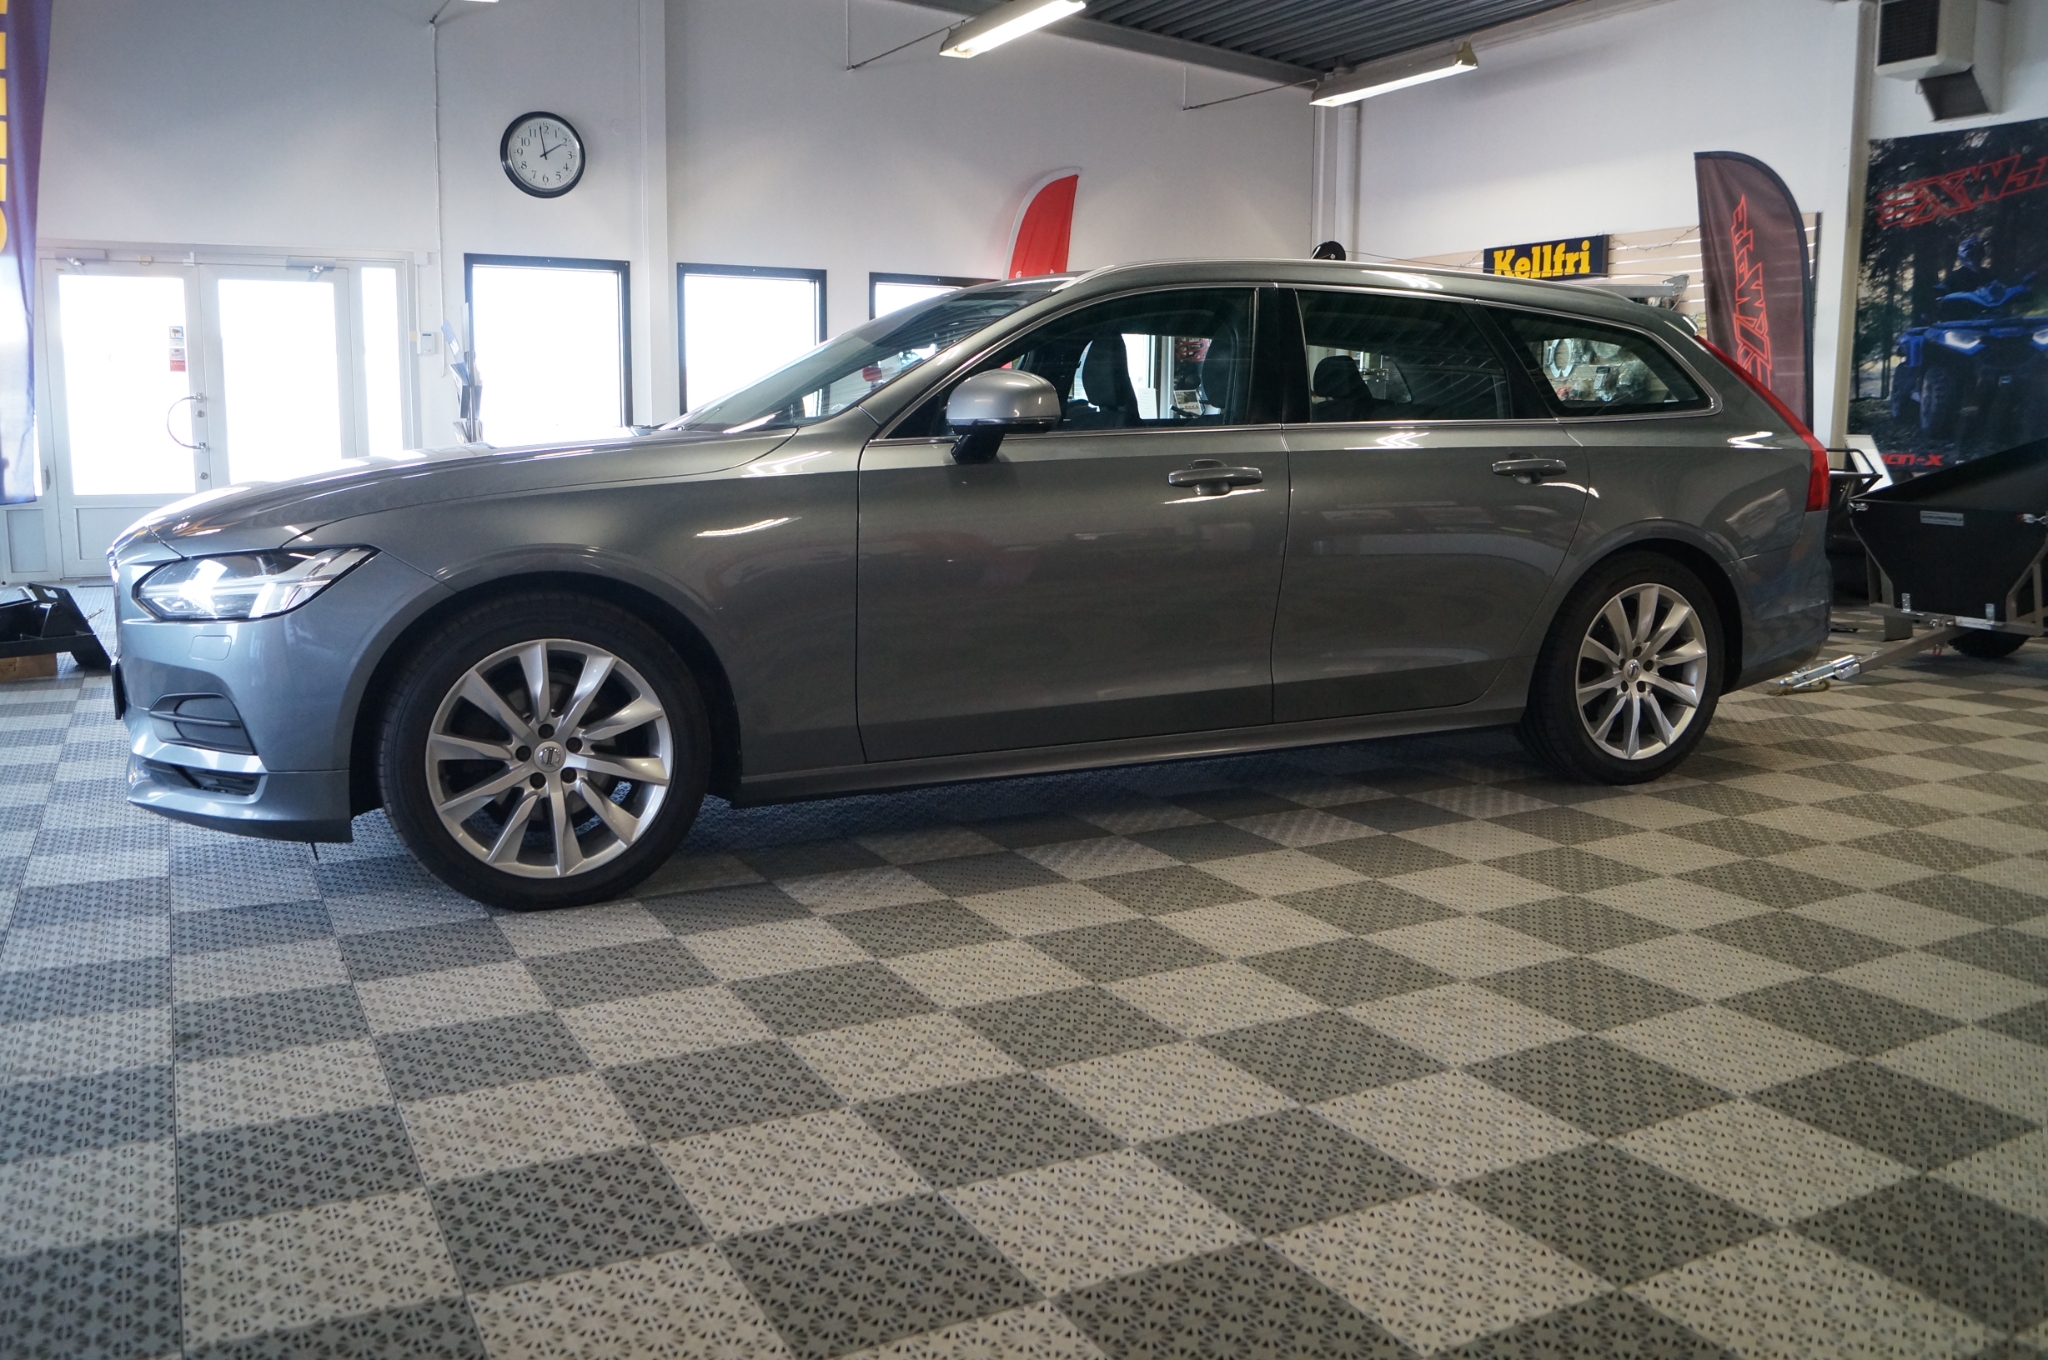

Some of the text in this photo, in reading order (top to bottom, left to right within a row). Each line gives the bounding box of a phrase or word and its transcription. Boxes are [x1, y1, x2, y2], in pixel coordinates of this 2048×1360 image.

[529, 128, 537, 138] 11
[539, 125, 549, 135] 2
[554, 130, 558, 138] 1
[521, 137, 530, 147] 10
[560, 137, 568, 147] 2
[516, 148, 523, 156] 9
[567, 151, 573, 159] 3
[521, 161, 527, 169] 8
[563, 163, 569, 171] 4
[531, 170, 537, 179] 7
[542, 174, 549, 183] 6
[555, 171, 562, 180] 5
[1493, 239, 1590, 279] Kellfri
